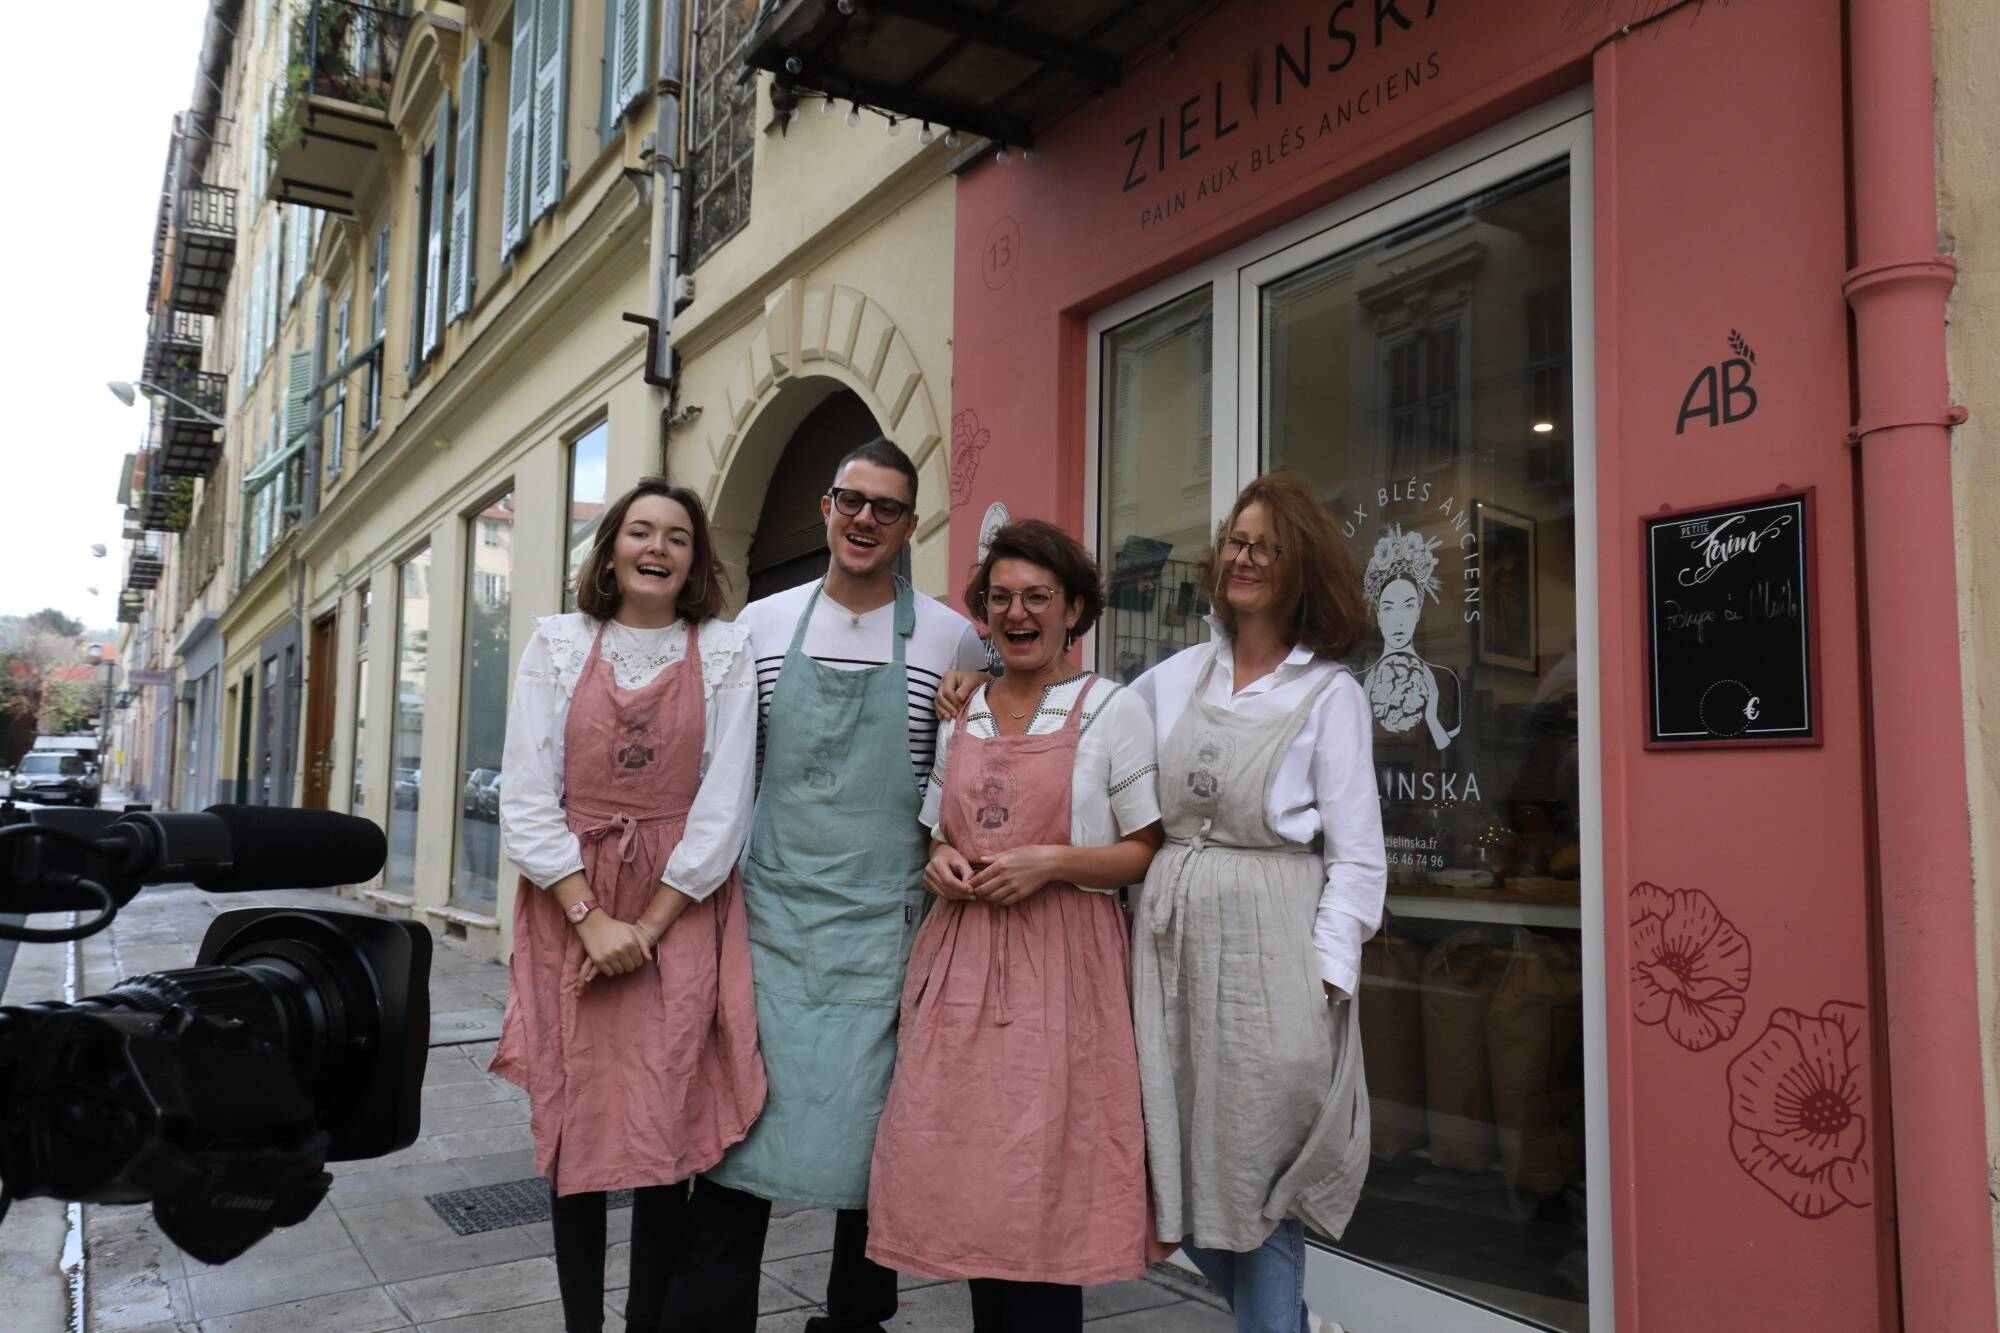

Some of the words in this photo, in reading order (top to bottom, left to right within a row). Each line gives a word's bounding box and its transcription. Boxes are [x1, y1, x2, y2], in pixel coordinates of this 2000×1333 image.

[1122, 0, 1436, 192] ZIELINSK
[1141, 189, 1186, 231] PAIN
[1196, 162, 1239, 202] AUX
[1250, 126, 1306, 173] BLÉS
[1318, 52, 1441, 138] ANCIENS
[990, 234, 1010, 271] 13
[1676, 358, 1757, 435] AB
[1681, 522, 1709, 536] PETITE
[1342, 503, 1368, 538] UX
[1377, 476, 1432, 507] BLÉS
[1439, 496, 1480, 623] ANCIENS
[1742, 696, 1760, 720] €
[1379, 767, 1481, 801] INSKA
[1402, 853, 1414, 865] 46
[1416, 854, 1428, 867] 74
[1430, 855, 1444, 868] 96
[211, 1191, 274, 1210] Canon
